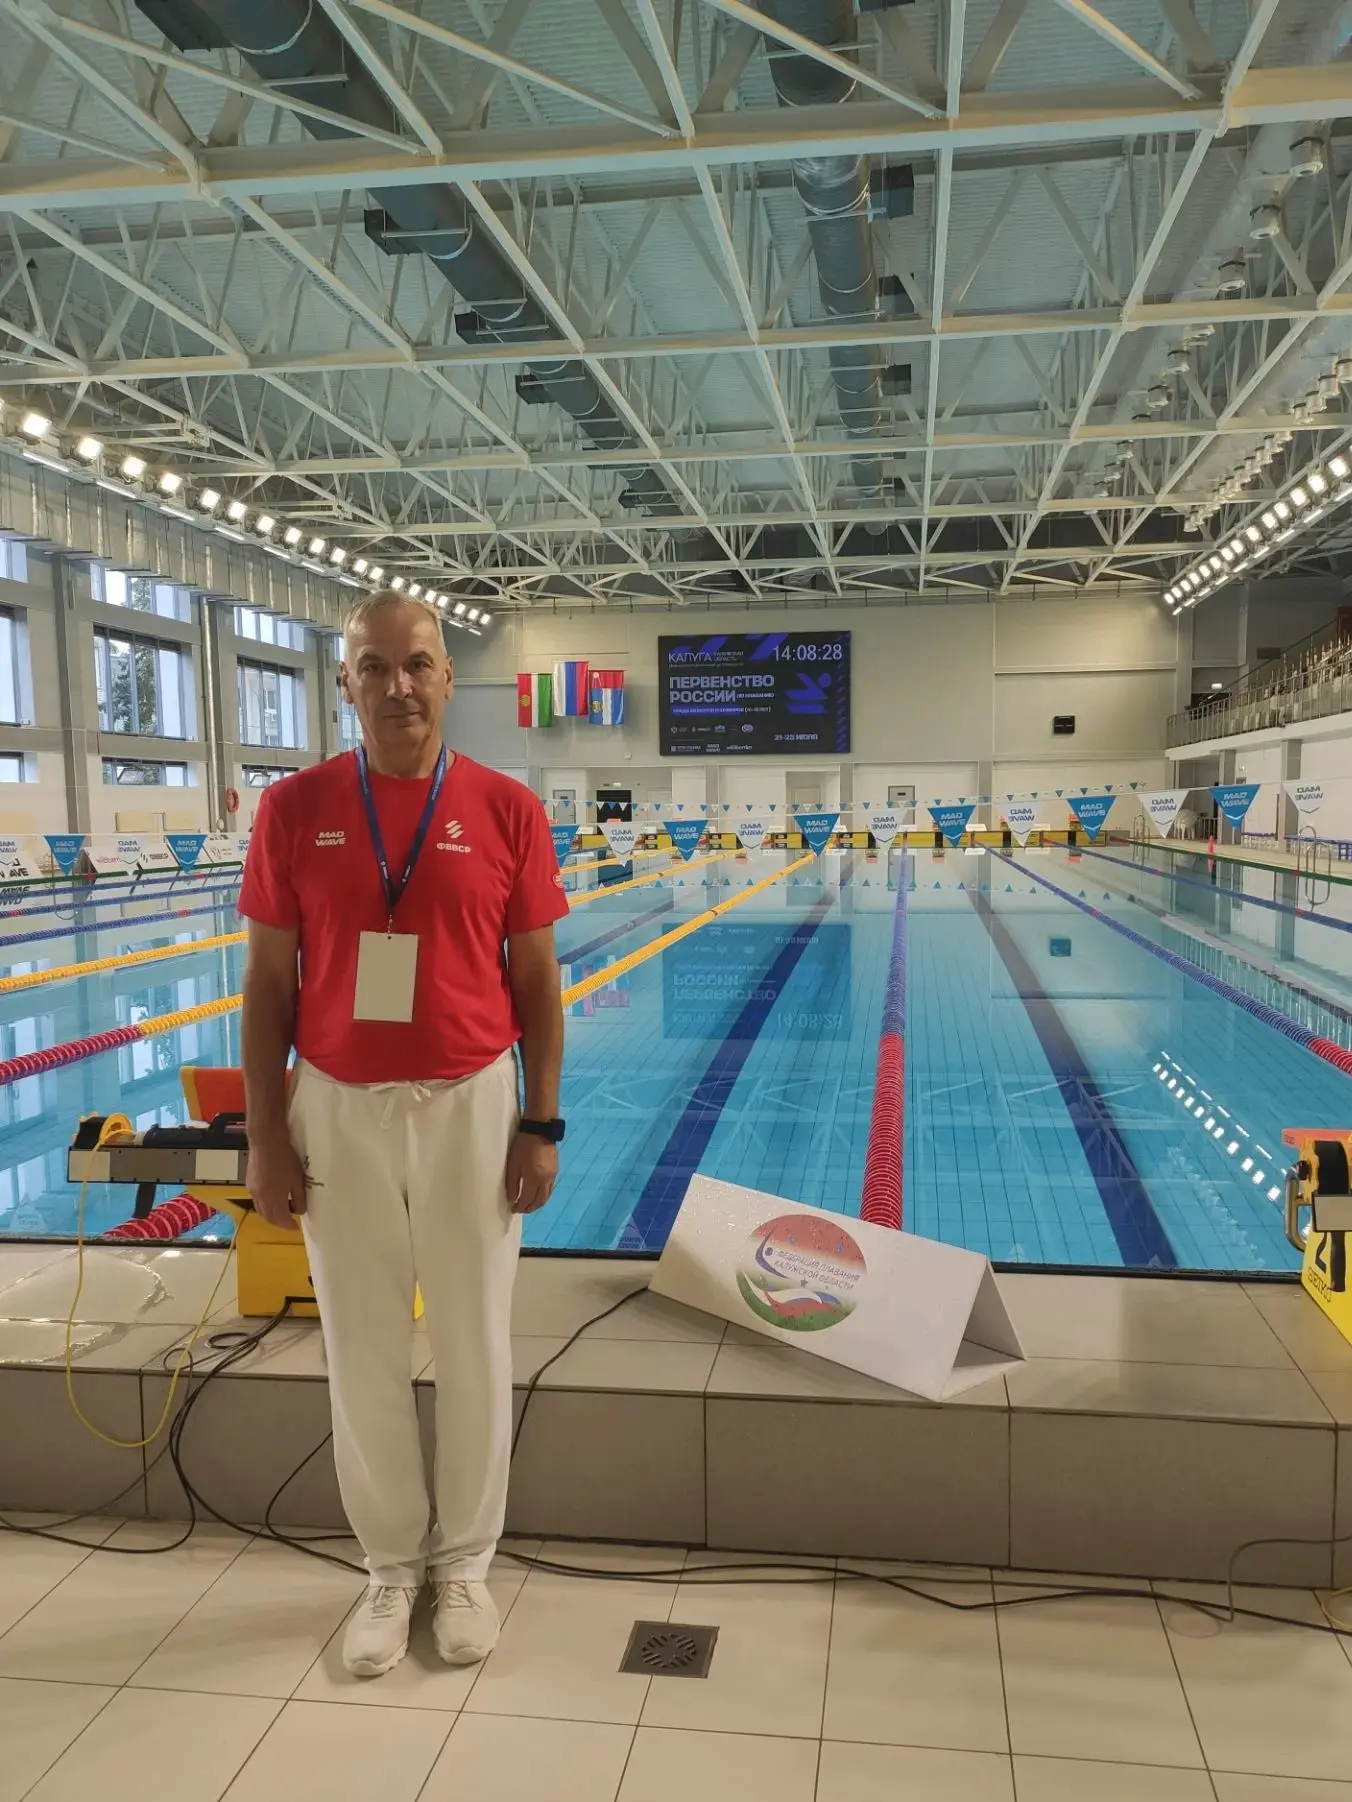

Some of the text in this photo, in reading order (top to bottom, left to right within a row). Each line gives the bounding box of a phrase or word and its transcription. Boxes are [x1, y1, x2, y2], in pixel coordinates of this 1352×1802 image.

[669, 652, 712, 662] КАЛУГА
[773, 644, 842, 661] 14:08:28
[669, 675, 775, 689] ПЕРВЕНСТВО
[670, 690, 736, 703] РОССИИ
[1223, 791, 1247, 799] MAD
[1080, 803, 1103, 811] MAD
[1221, 799, 1250, 807] WAVE
[1078, 810, 1106, 818] WAVE
[939, 819, 966, 827] WAVE
[804, 826, 830, 834] WAVE
[315, 838, 346, 846] WAVE
[774, 1259, 854, 1290] КАЛУЖСКОЙ ОБЛАСТИ
[820, 1263, 860, 1282] ПЛАВАНИЯ
[1307, 1267, 1332, 1303] SEIKO
